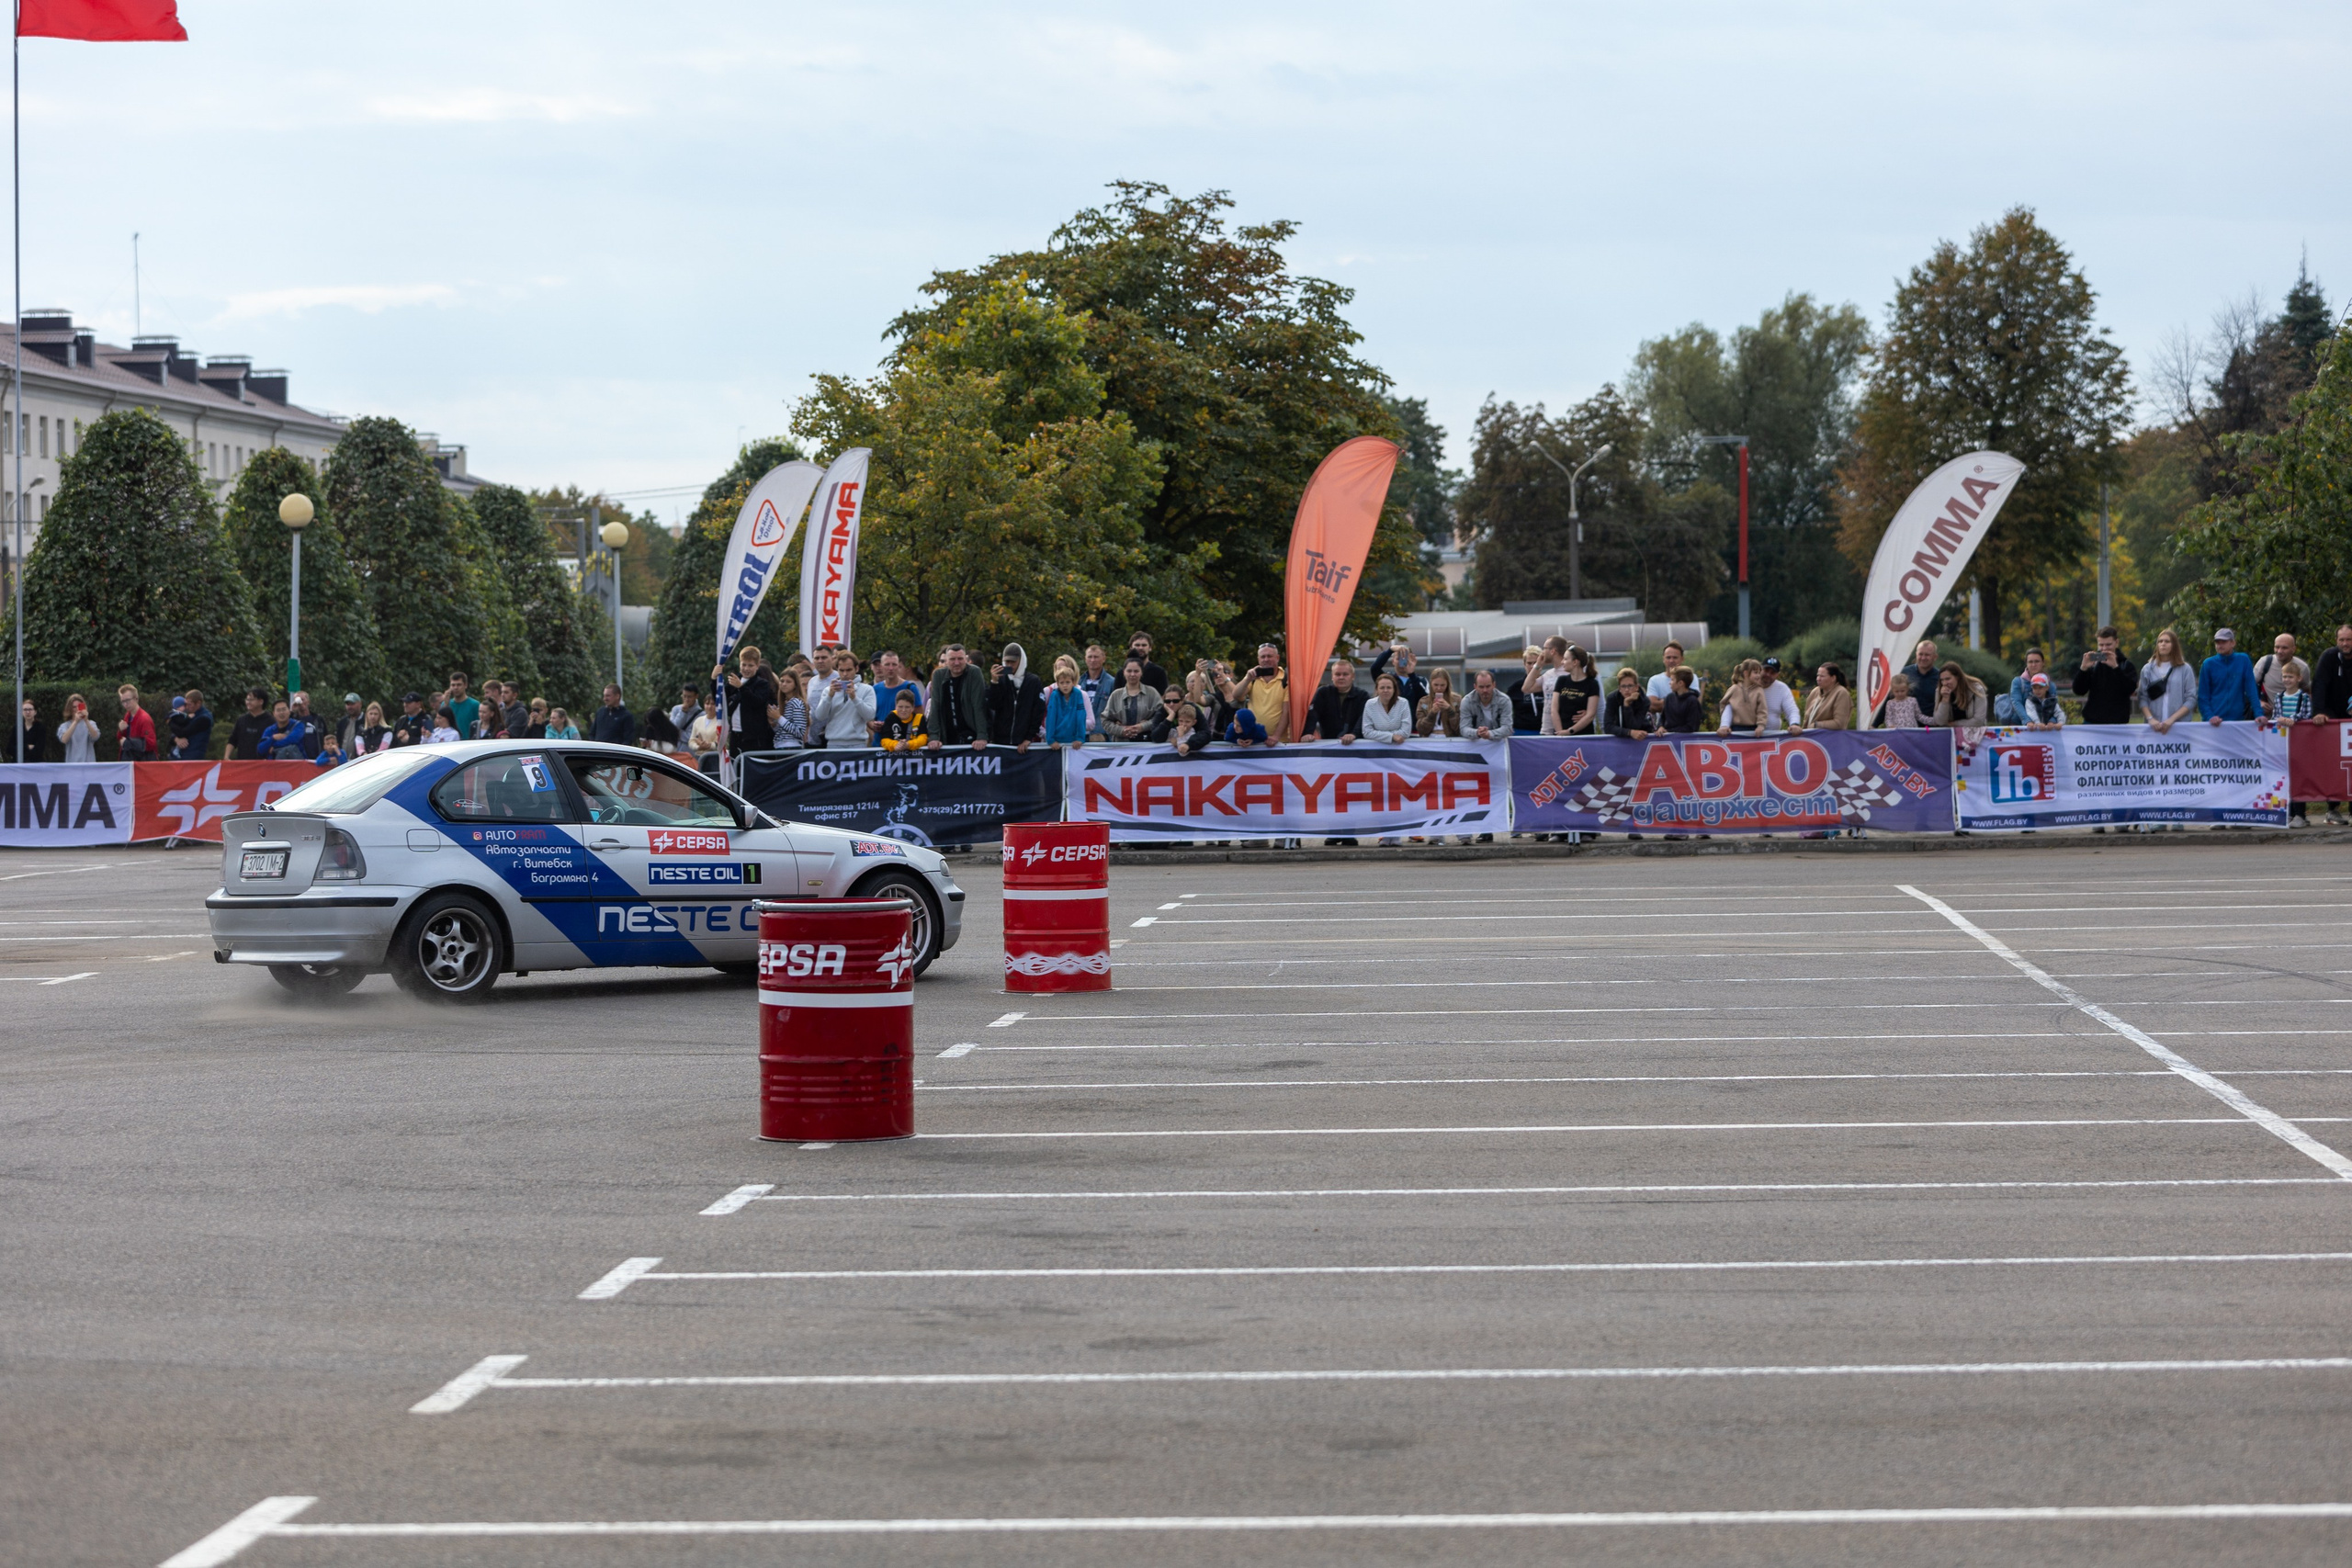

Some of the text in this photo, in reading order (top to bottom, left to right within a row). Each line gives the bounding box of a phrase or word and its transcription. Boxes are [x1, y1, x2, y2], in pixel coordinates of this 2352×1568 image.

[763, 515, 775, 538] Dinol
[1883, 477, 2000, 633] COMMA
[820, 482, 859, 647] KAYAMA
[1306, 548, 1351, 593] Taif
[2075, 742, 2191, 755] ФЛАГИ И ФЛАЖКИ
[797, 756, 1001, 782] ПОДШИПНИКИ
[1627, 737, 1832, 805] АВТО
[1866, 742, 1937, 800] ADT.BY
[2075, 758, 2262, 772] КОРПОРАТИВНАЯ СИМВОЛИКА
[531, 766, 548, 789] 9
[1528, 747, 1589, 808] ADT.BY
[2077, 773, 2262, 787] ФЛАГШТОКИ И КОНСТРУКЦИИ
[1083, 771, 1490, 818] NAKAYAMA
[2077, 791, 2125, 800] различных
[2127, 789, 2153, 798] видов
[2163, 787, 2205, 797] размеров
[798, 801, 879, 814] Тимирязева 121/4
[918, 803, 1005, 816] +375(29)2117773
[1632, 795, 1838, 826] дайджест
[814, 811, 859, 821] офис 517
[1972, 818, 2028, 827] WWW.FLAG.BY
[2054, 813, 2112, 823] WWW.FLAG.BY
[2139, 811, 2196, 820] WWW.FLAG.BY
[2222, 812, 2278, 822] WWW.FLAG.BY
[486, 829, 547, 840] AUTOFRAM
[486, 844, 571, 856] Автозапчасти
[676, 836, 726, 850] CEPSA
[857, 840, 898, 854] ADT.BY
[1050, 844, 1106, 863] CEPSA
[525, 858, 572, 868] Витебск
[531, 873, 599, 885] Баграмяна 4
[650, 867, 740, 880] NESTE OIL
[747, 864, 756, 883] 1
[598, 905, 732, 932] NESTE
[759, 943, 846, 976] EPSA
